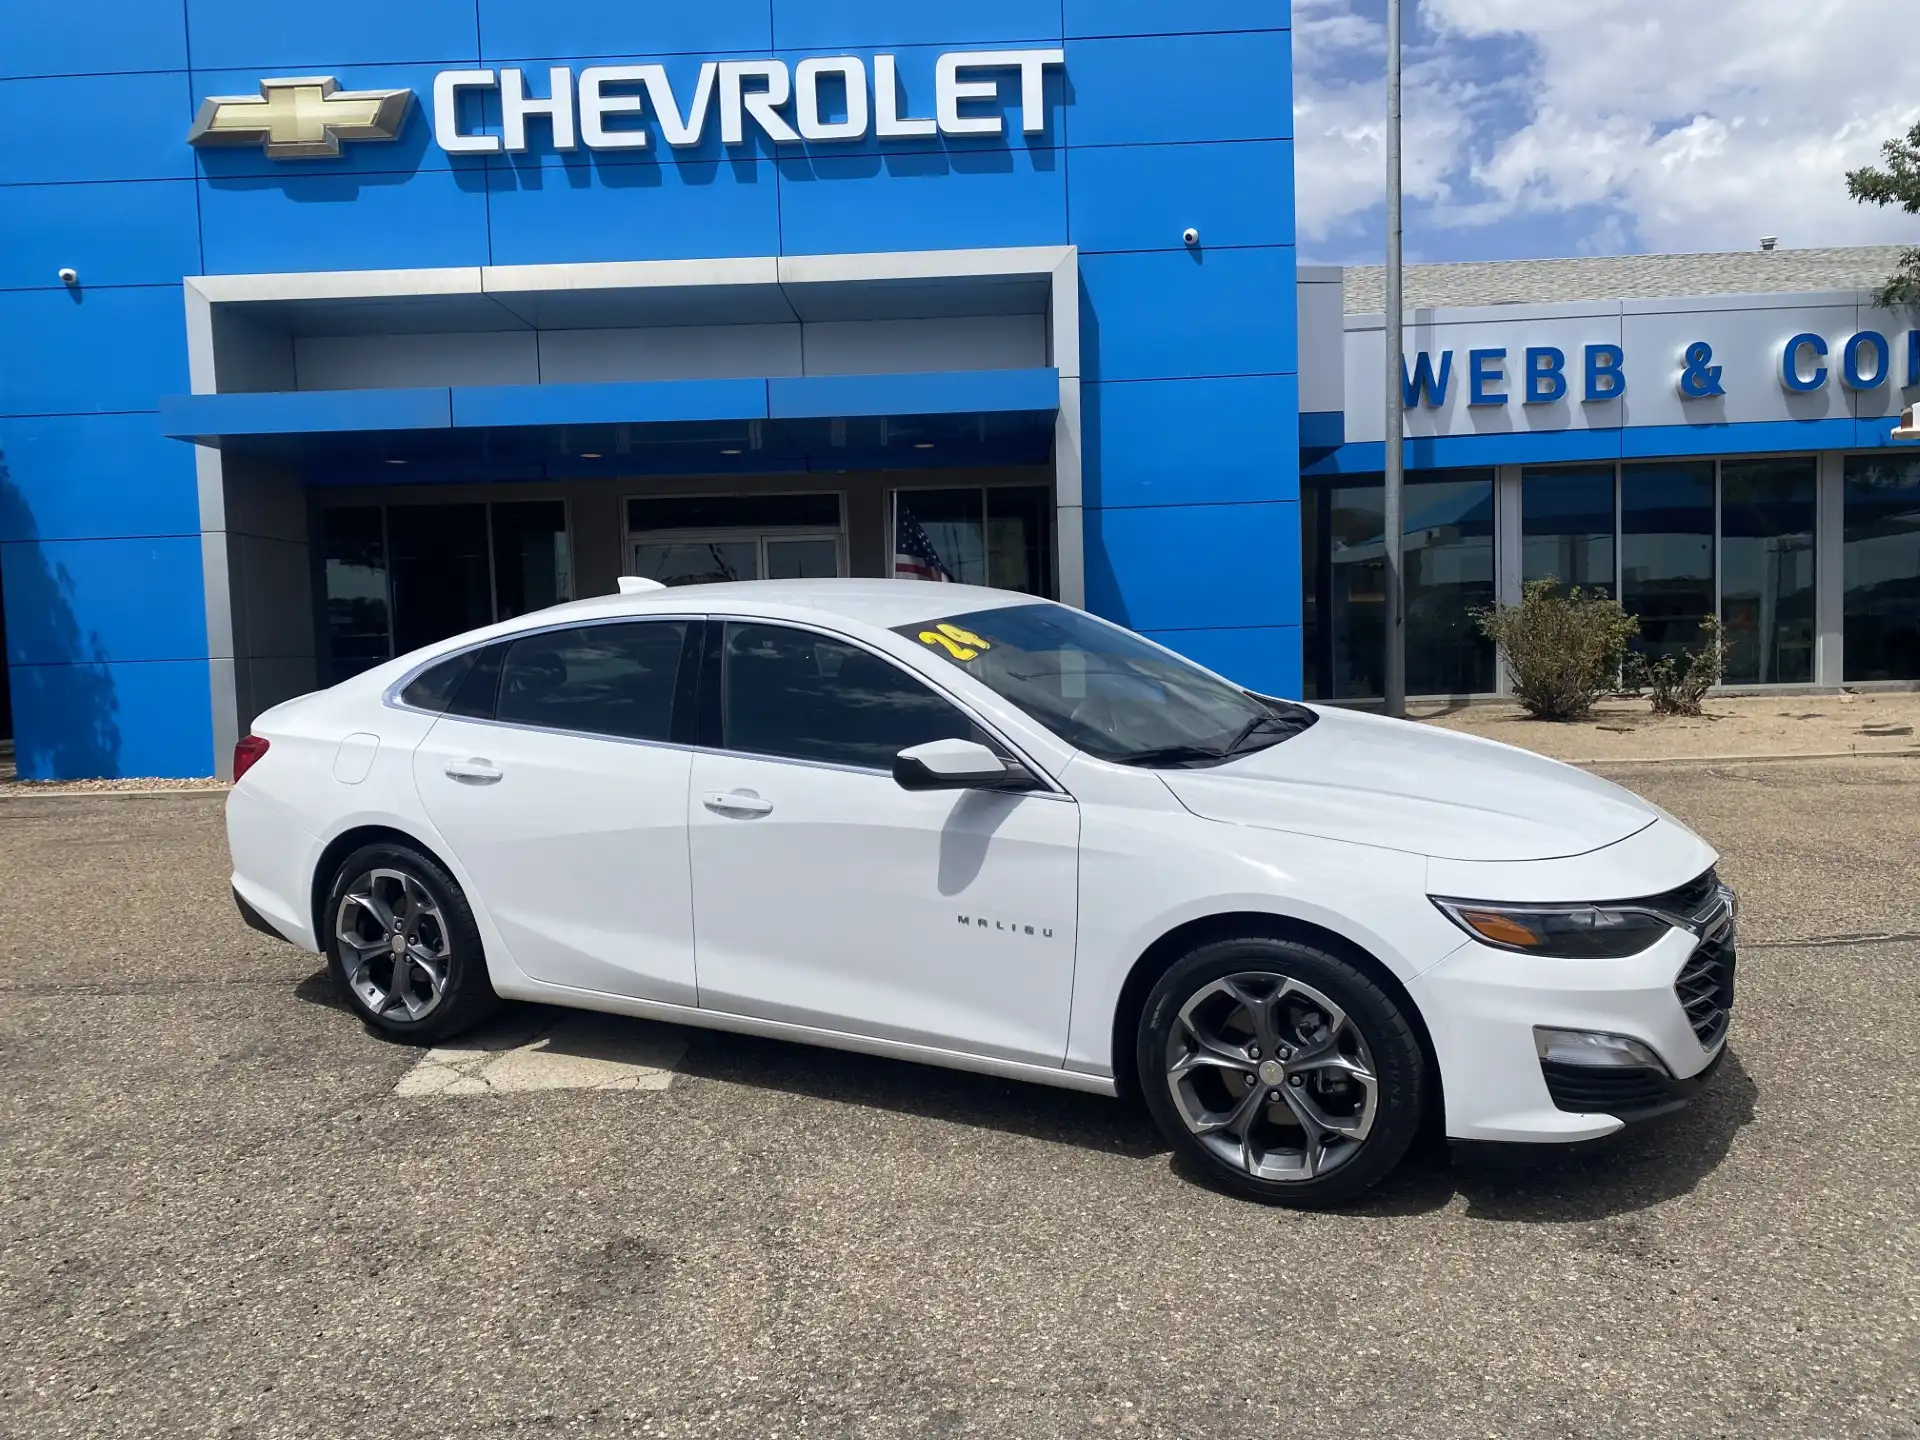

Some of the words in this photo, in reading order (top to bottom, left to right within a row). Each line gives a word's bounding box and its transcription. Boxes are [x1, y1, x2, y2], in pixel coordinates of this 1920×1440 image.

[433, 48, 1064, 153] CHEVROLET
[1401, 344, 1626, 408] WEBB
[1681, 341, 1726, 398] &
[1783, 330, 1920, 392] CO
[918, 623, 991, 661] 24
[957, 915, 1053, 938] MALIBU
